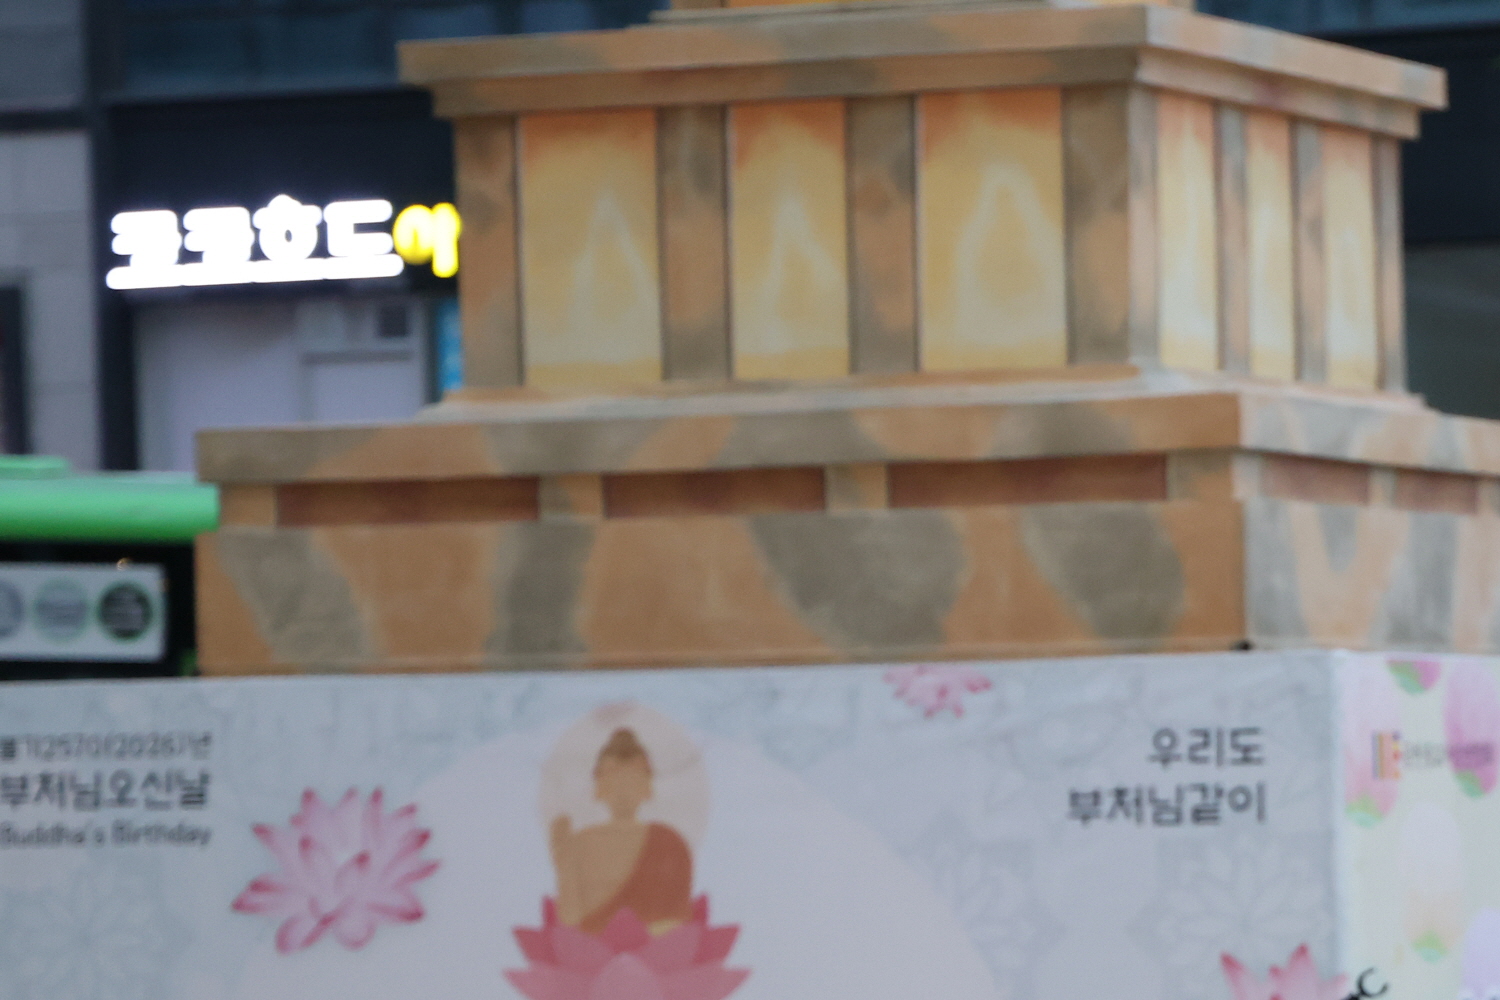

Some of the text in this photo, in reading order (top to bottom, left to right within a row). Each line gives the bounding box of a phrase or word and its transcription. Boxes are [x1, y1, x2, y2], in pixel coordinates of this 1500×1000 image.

[1148, 727, 1265, 768] 우리도
[0, 768, 210, 812] 부처님오신날
[1067, 780, 1266, 827] 부처님같이
